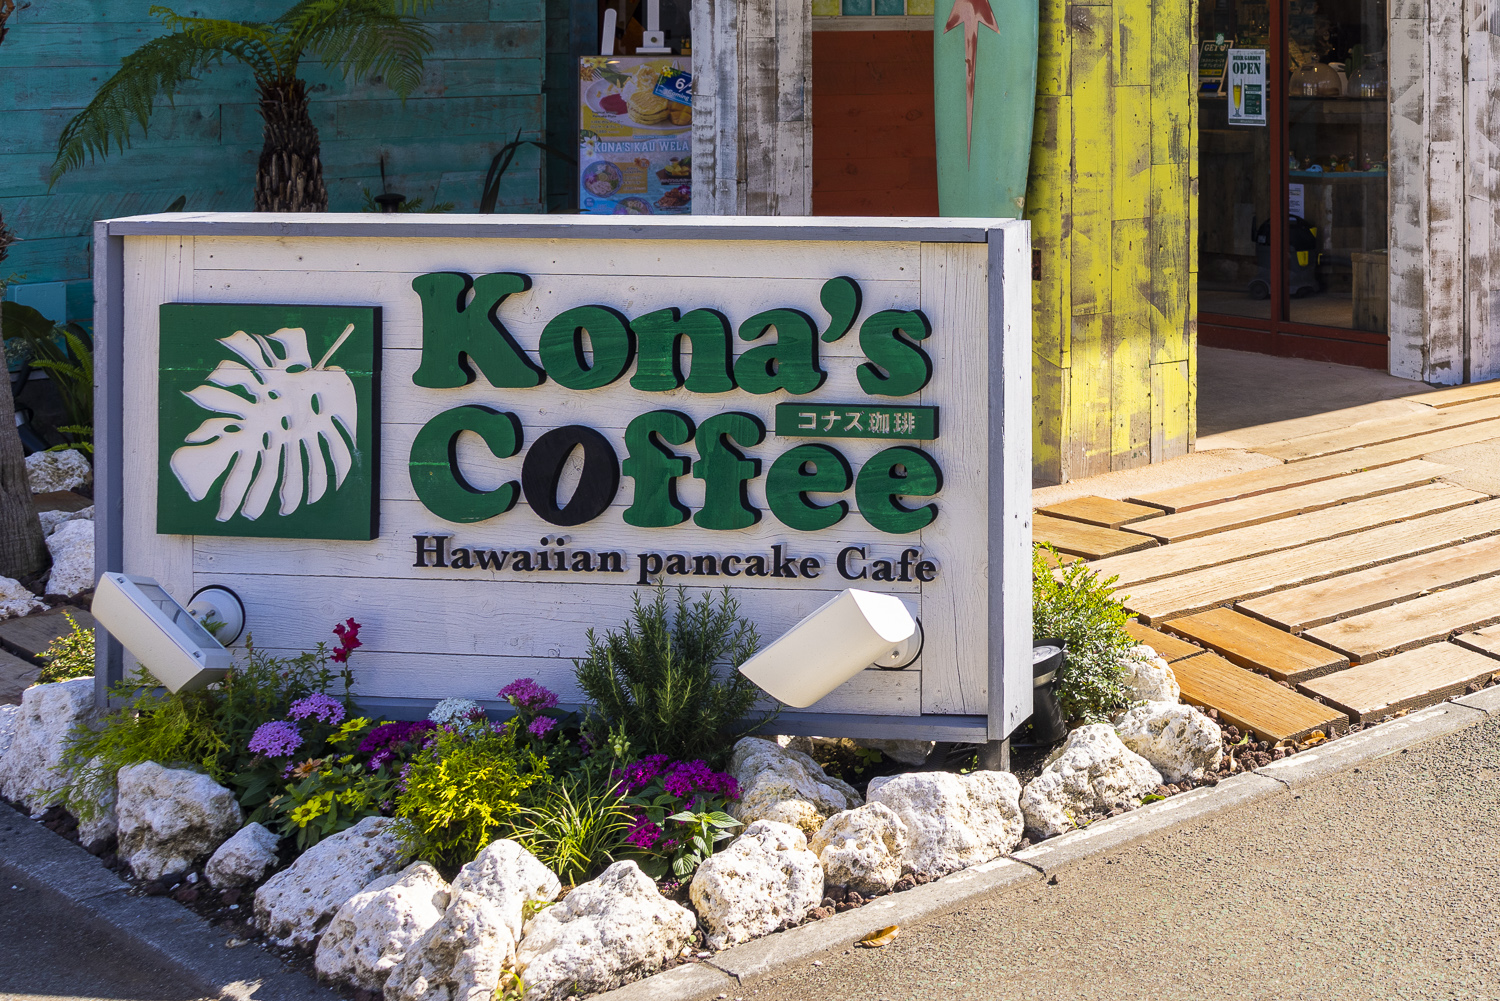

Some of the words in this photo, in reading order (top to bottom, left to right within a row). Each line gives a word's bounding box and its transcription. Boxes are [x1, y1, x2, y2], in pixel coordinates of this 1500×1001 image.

[1232, 62, 1261, 74] OPEN
[594, 142, 631, 152] KONA'S
[634, 142, 656, 151] KAU
[659, 141, 690, 151] WELA
[411, 271, 933, 396] Kona's
[797, 409, 917, 436] コナズ珈琲
[408, 404, 944, 534] Coffee
[412, 534, 627, 572] Hawaiian
[636, 543, 821, 585] pancake
[836, 545, 938, 582] Cafe
